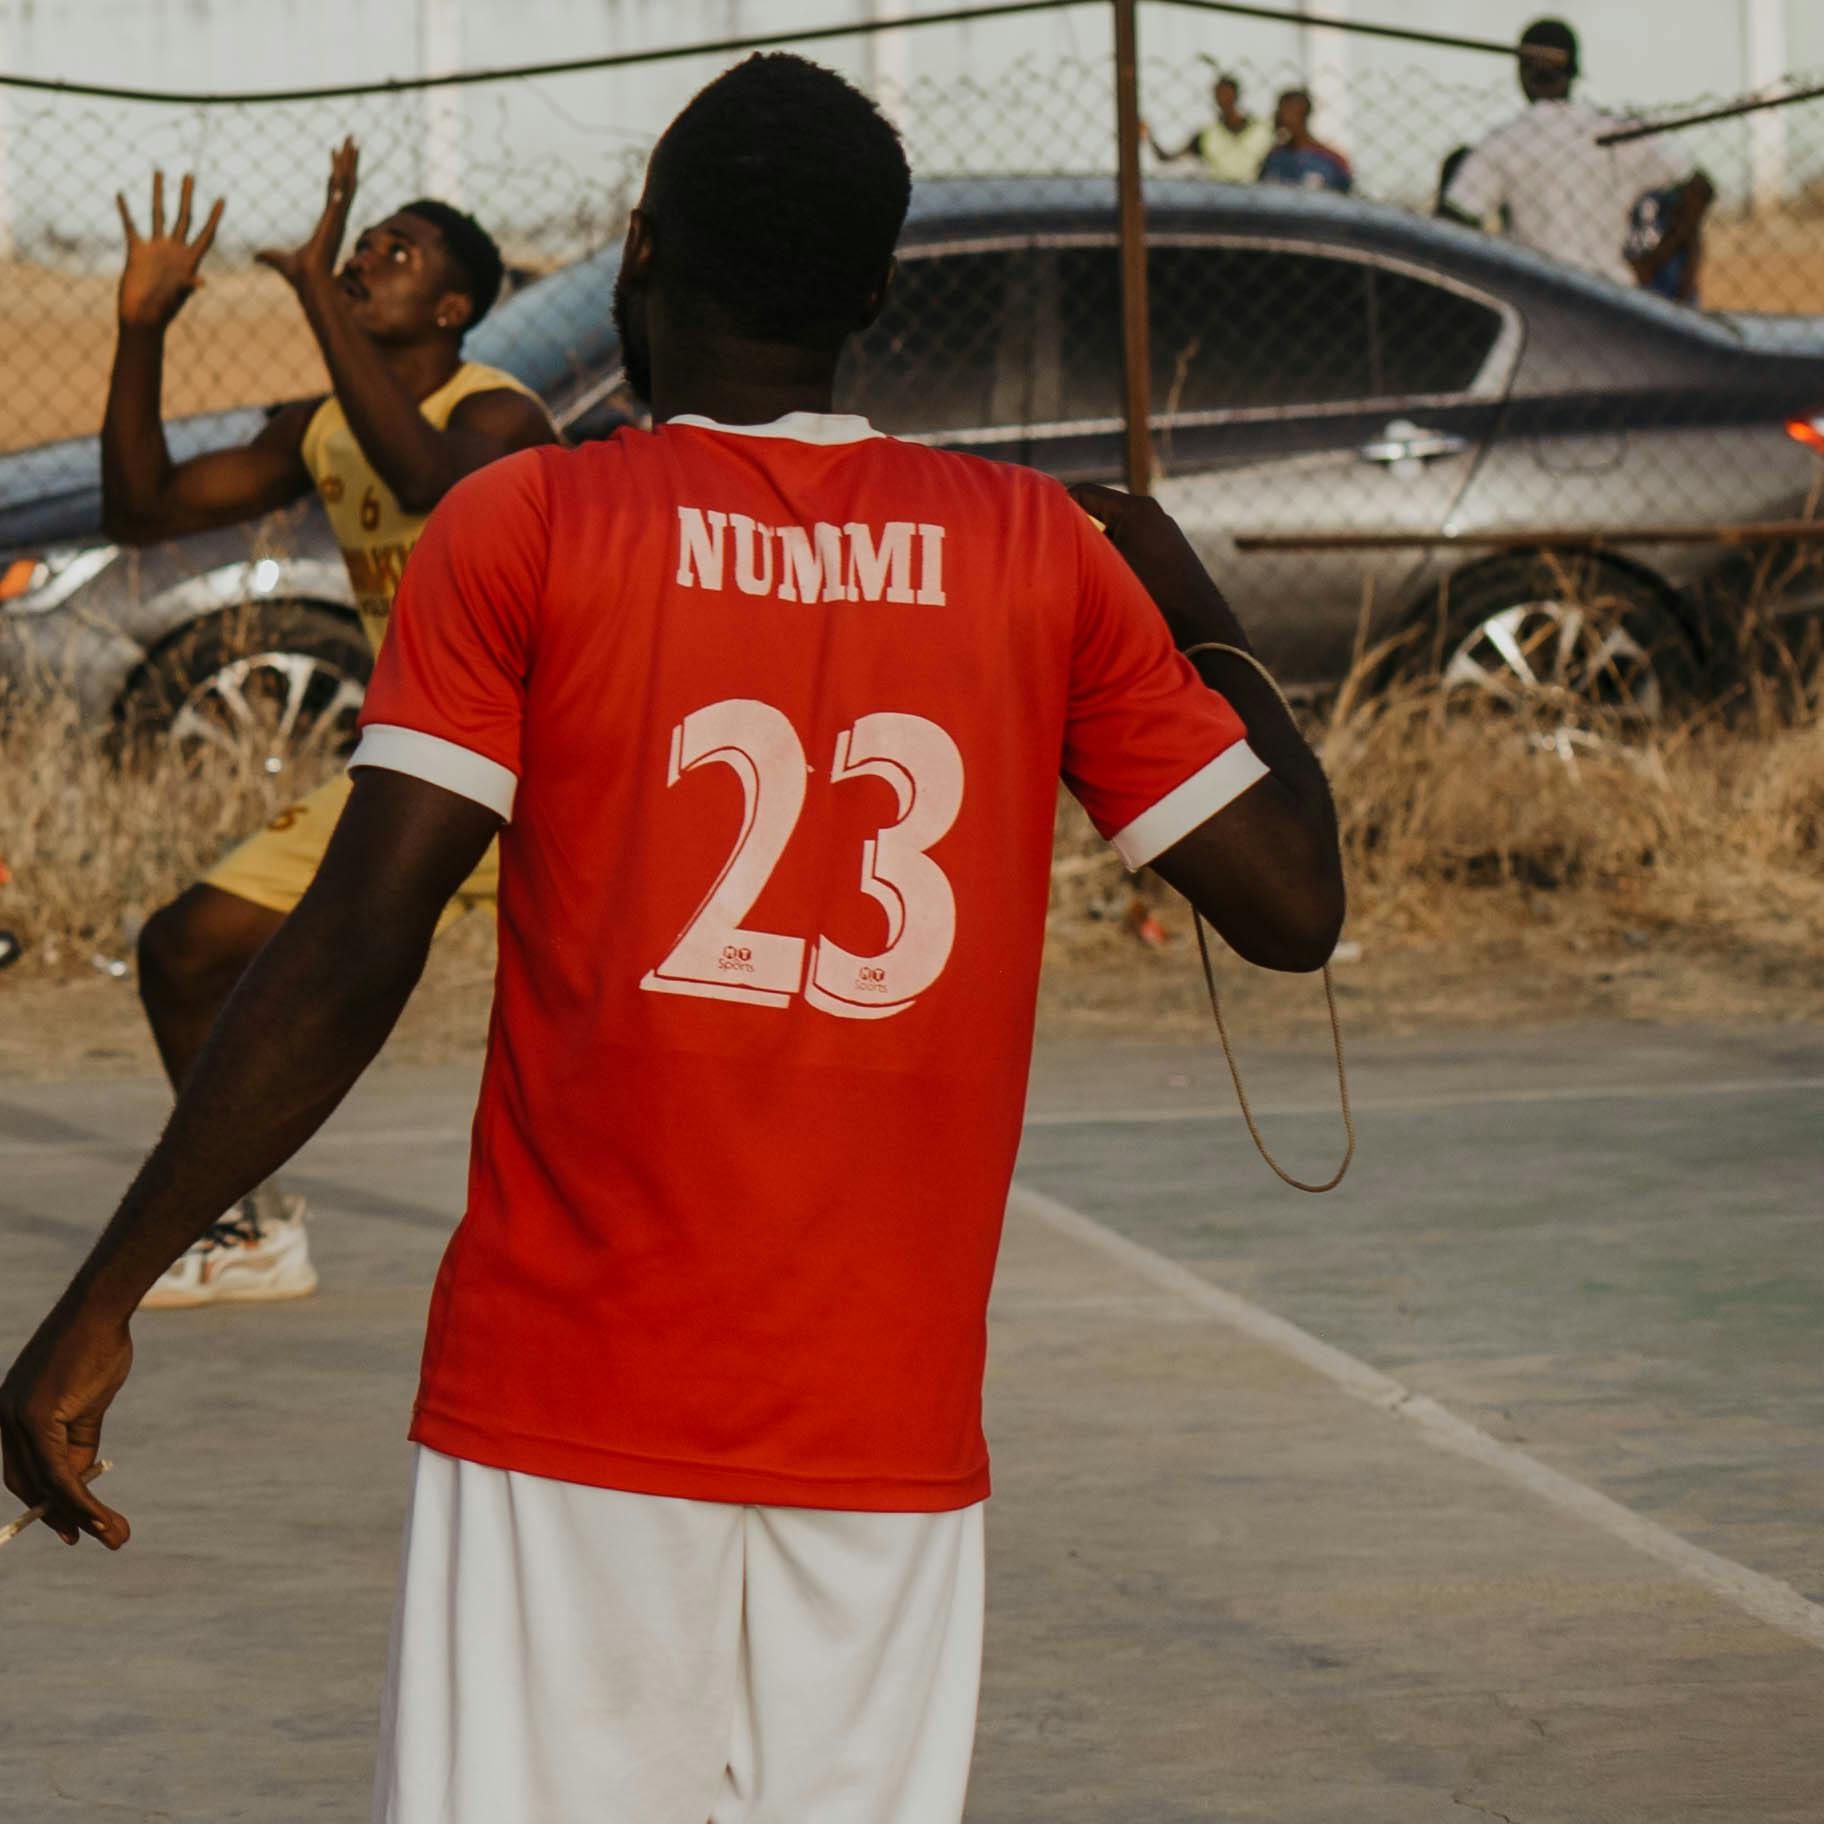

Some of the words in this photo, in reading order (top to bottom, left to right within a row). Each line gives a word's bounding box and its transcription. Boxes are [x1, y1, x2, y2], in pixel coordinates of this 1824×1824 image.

[360, 485, 380, 532] 6
[676, 505, 946, 606] NUMMI
[639, 698, 964, 1019] 23
[718, 958, 754, 973] Sports
